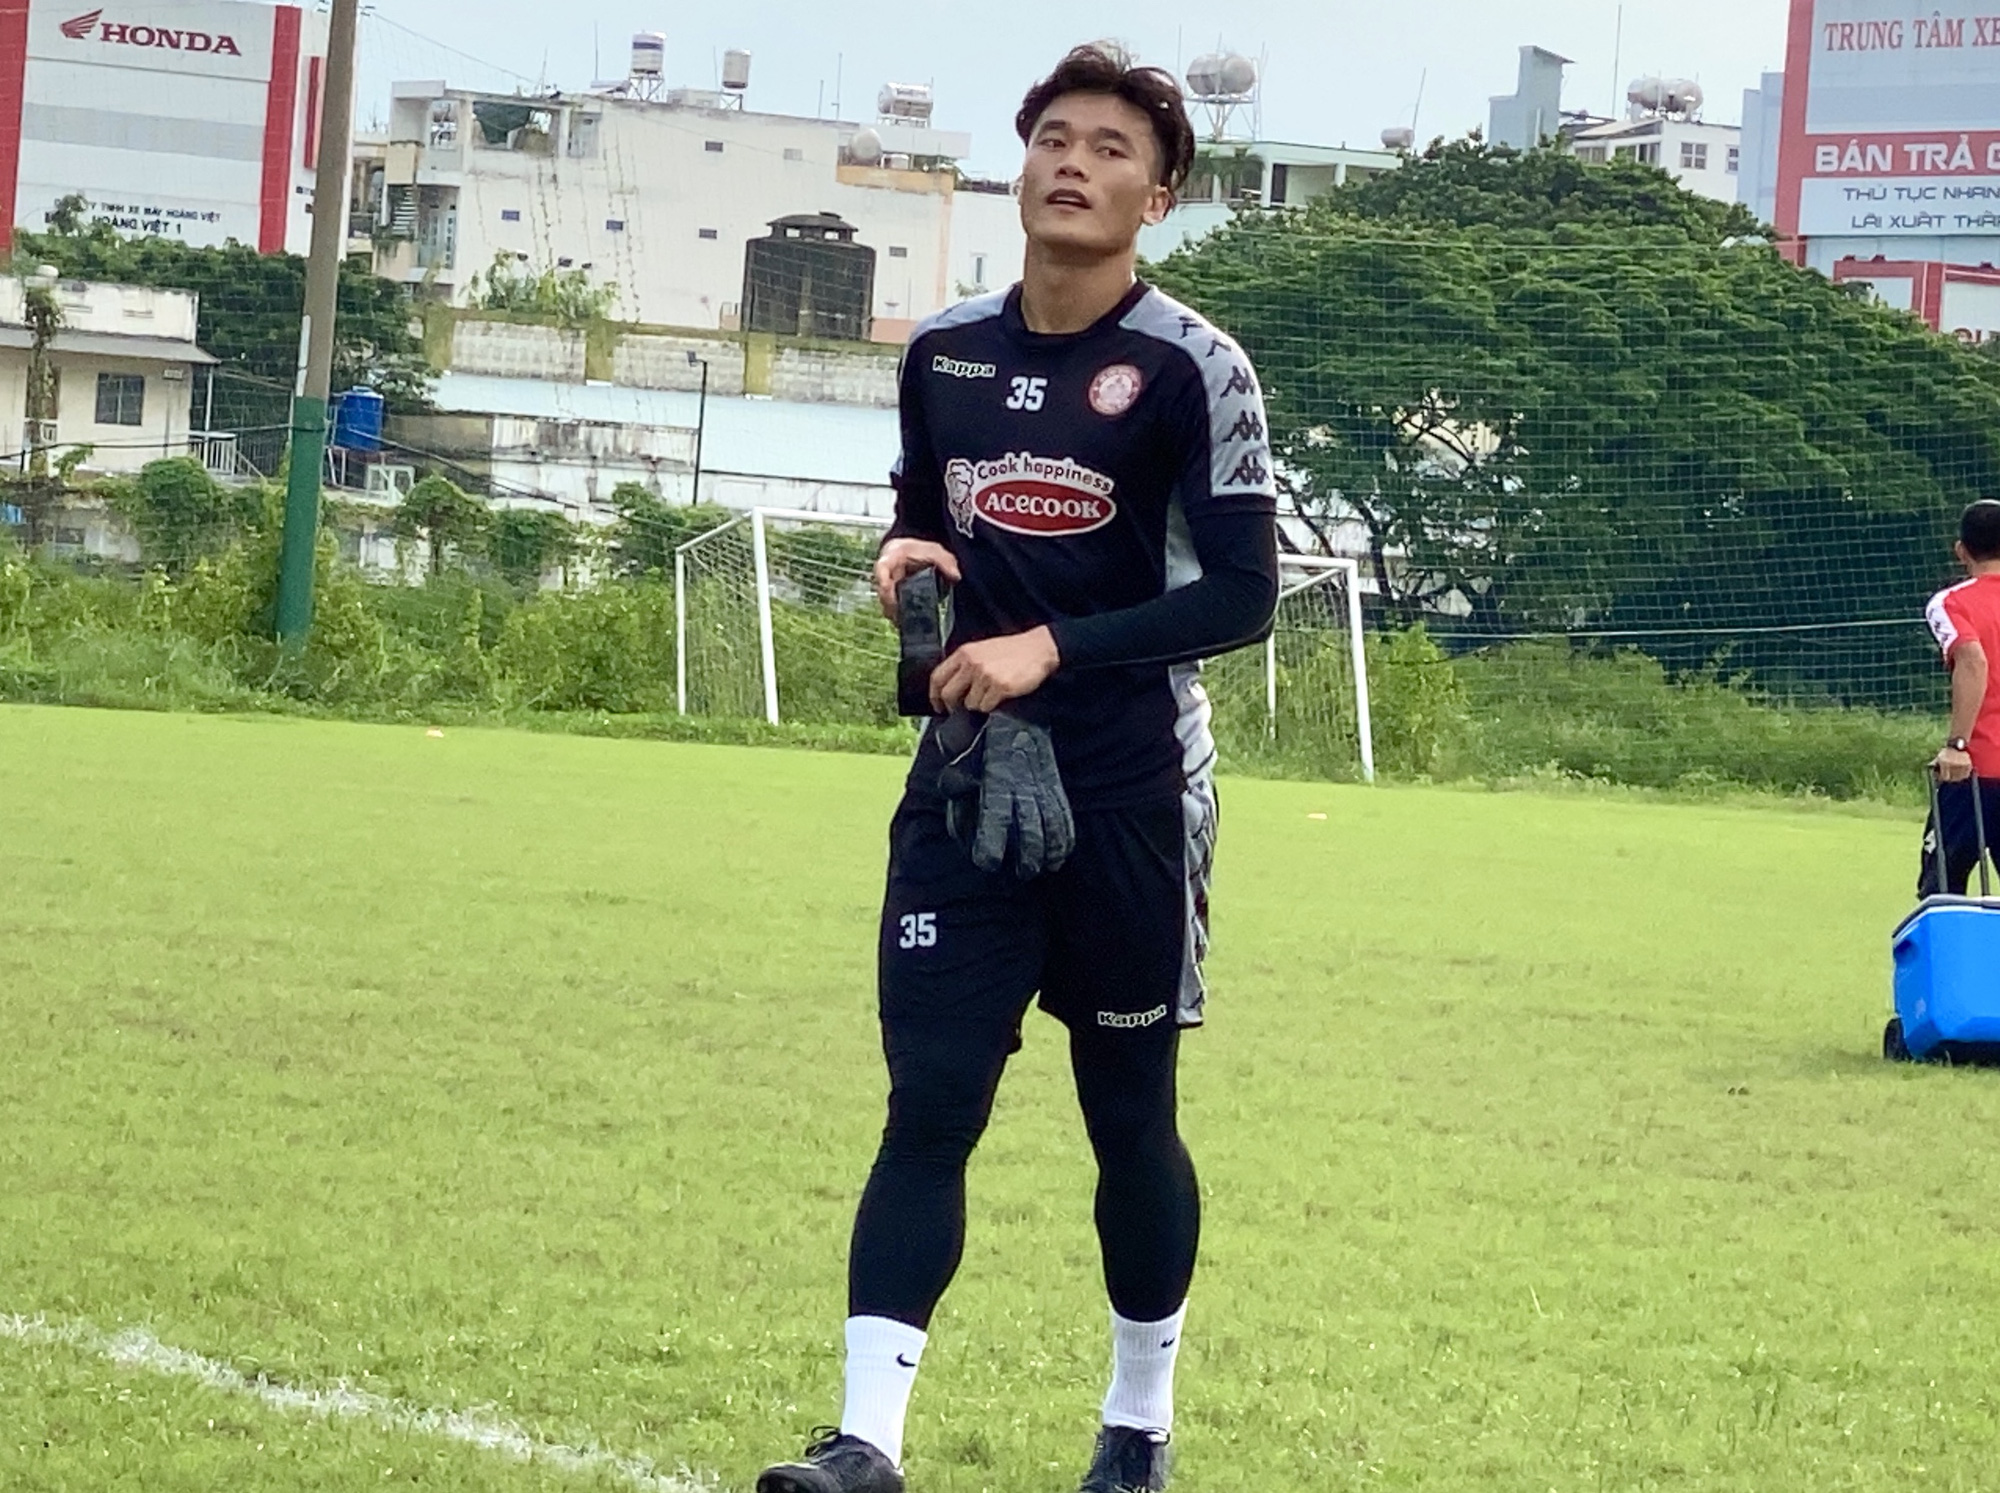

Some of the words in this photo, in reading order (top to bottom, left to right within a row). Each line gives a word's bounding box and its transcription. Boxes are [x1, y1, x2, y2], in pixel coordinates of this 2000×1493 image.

[100, 22, 242, 57] HONDA
[1824, 20, 1903, 51] TRUNG
[1913, 10, 1965, 48] TÂM
[1815, 138, 1893, 173] BÁN
[1903, 133, 1976, 171] TRẢ
[1894, 186, 1938, 203] TỤC
[933, 356, 996, 378] Kappa
[1006, 376, 1048, 411] 35
[977, 457, 1019, 480] Cook
[1023, 455, 1112, 493] happiness
[899, 912, 937, 949] 35
[1097, 1004, 1167, 1027] Kappa
